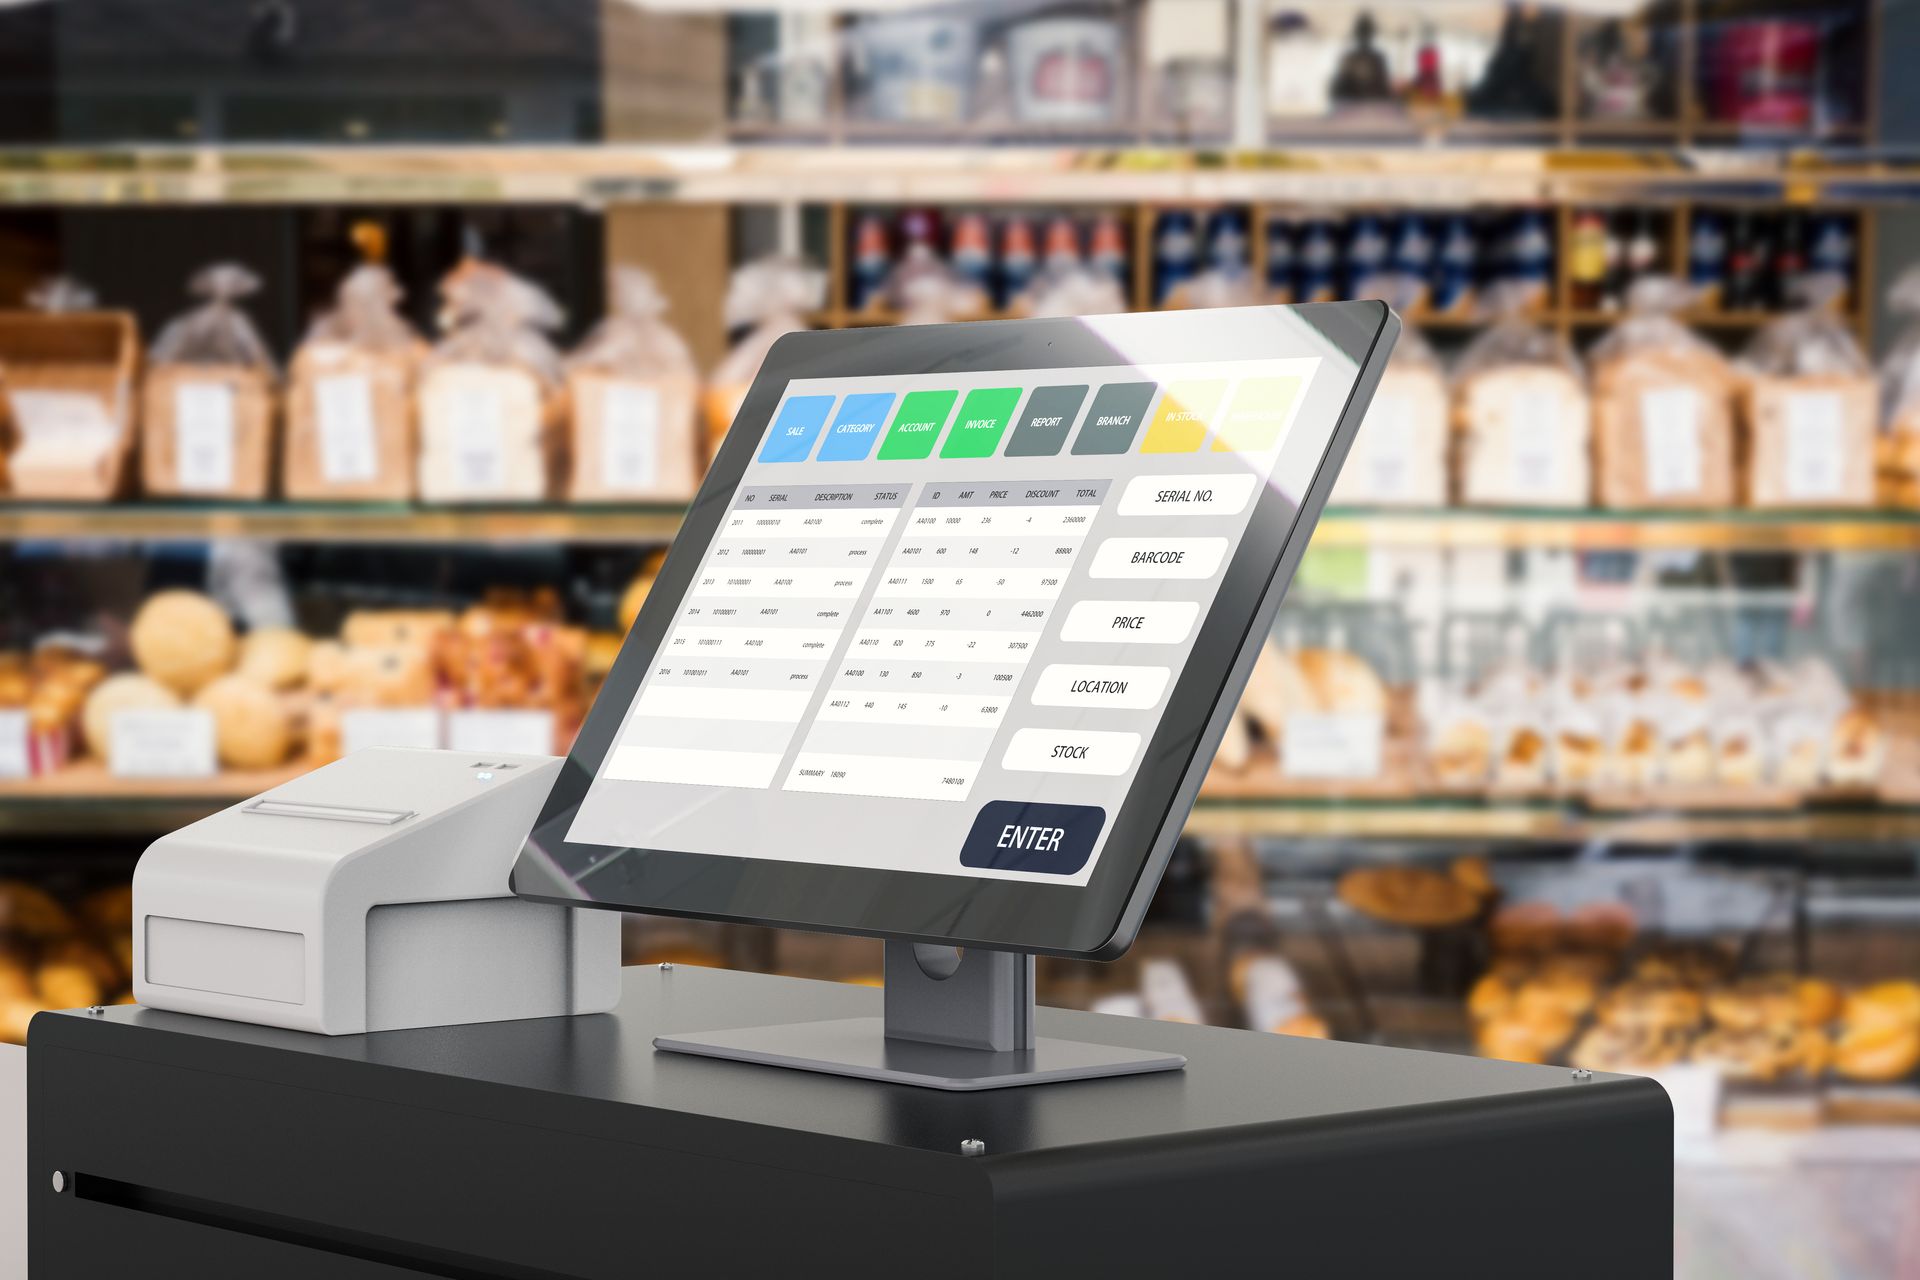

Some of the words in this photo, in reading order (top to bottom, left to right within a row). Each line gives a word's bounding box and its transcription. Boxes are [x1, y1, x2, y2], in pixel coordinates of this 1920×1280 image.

[964, 418, 998, 430] INVOICE
[1030, 416, 1063, 428] REPORT
[1096, 415, 1132, 426] BRANCH
[785, 426, 806, 436] SALE
[836, 423, 876, 434] CATEGORY
[897, 422, 937, 433] ACCOUNT
[744, 494, 756, 503] NO
[768, 493, 789, 502] SERIAL
[814, 492, 854, 502] DESCRIPTION
[873, 491, 899, 501] STATUS
[931, 491, 941, 500] ID
[957, 490, 975, 500] AMT
[988, 490, 1009, 499] PRICE
[1024, 489, 1061, 499] DISCOUNT
[1075, 489, 1097, 498] TOTAL
[1154, 490, 1192, 503] SERIAL
[1192, 489, 1213, 502] NO.
[860, 518, 884, 527] complete
[847, 549, 868, 557] process
[1130, 551, 1186, 564] BARCODE
[833, 580, 853, 588] process
[816, 610, 840, 619] complete
[1111, 616, 1146, 629] PRICE
[802, 641, 825, 649] complete
[789, 673, 809, 681] process
[1070, 679, 1129, 694] LOCATION
[1050, 745, 1090, 760] STOCK
[798, 768, 826, 777] SUMMARY
[996, 824, 1065, 852] ENTER
